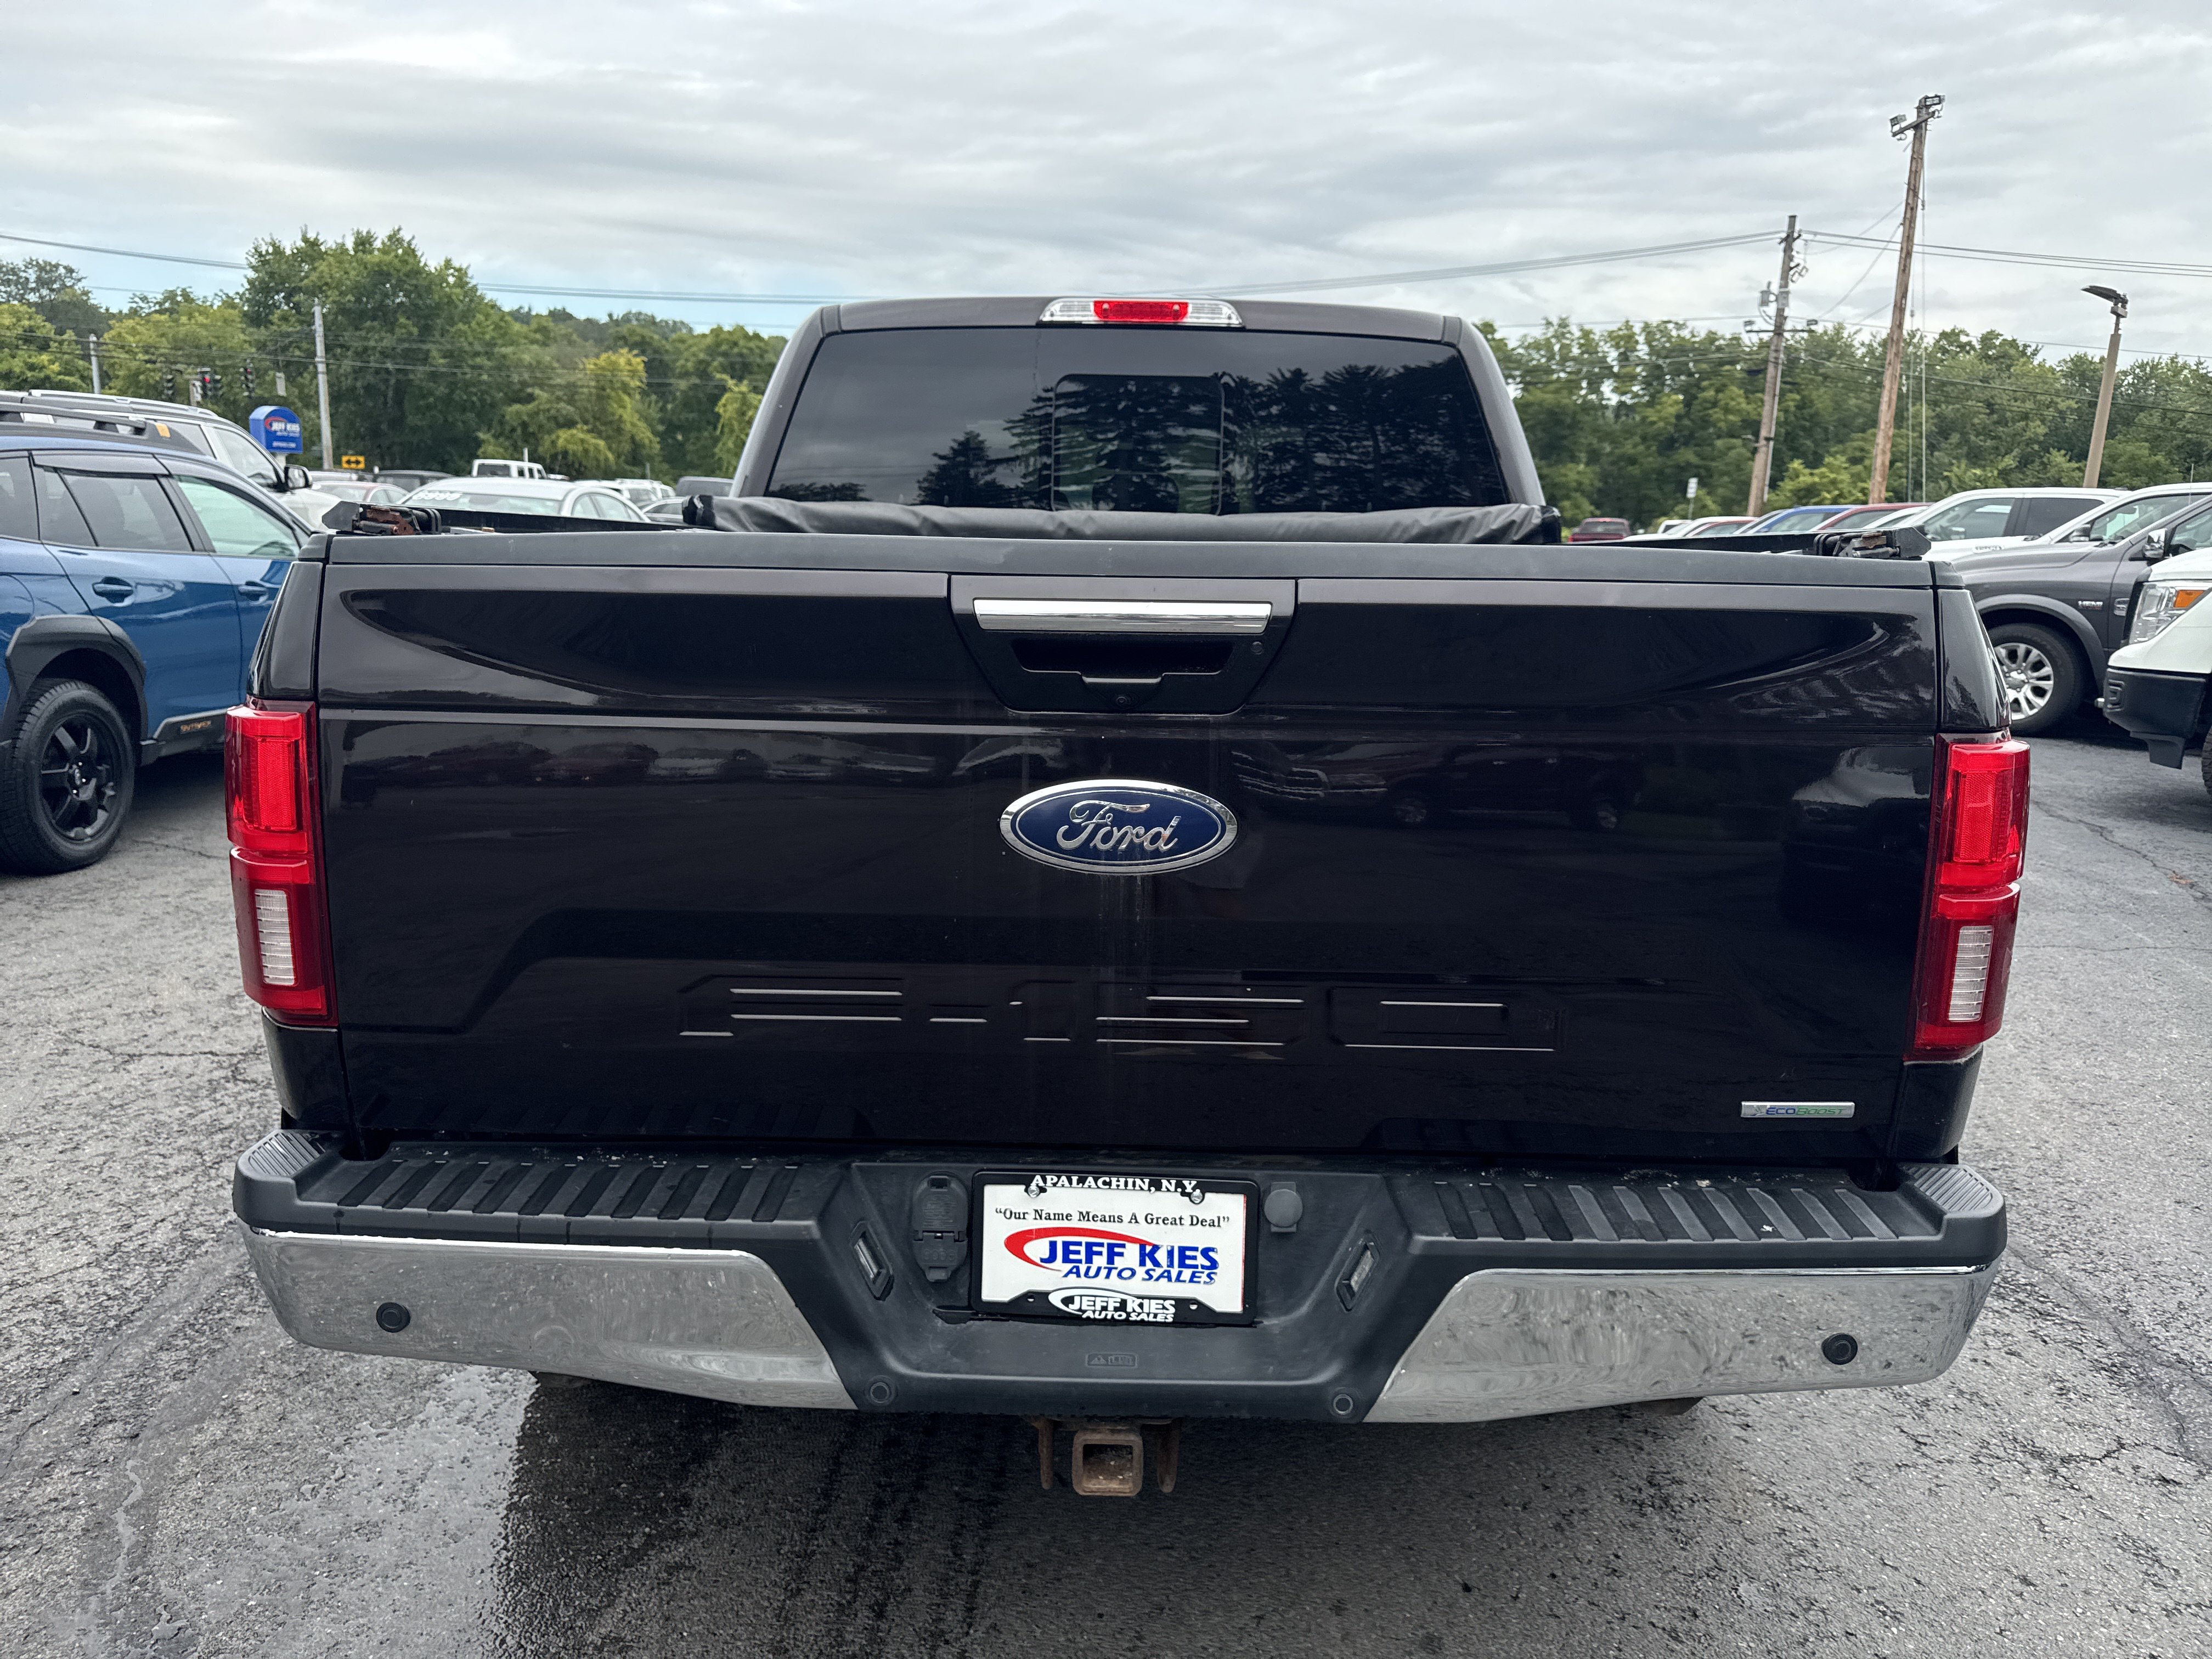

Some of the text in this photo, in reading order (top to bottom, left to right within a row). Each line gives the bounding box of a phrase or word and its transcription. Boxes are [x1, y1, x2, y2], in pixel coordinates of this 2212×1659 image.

[1056, 800, 1182, 852] Ford
[1030, 1175, 1155, 1193] APALACHIN,
[995, 1207, 1229, 1227] “Our Name Means A Great Deal”
[1040, 1240, 1219, 1271] JEFF KIES
[1062, 1265, 1218, 1285] AUTO SALES
[1068, 1296, 1176, 1314] JEFF KIES
[1081, 1311, 1175, 1323] AUTO SALES
